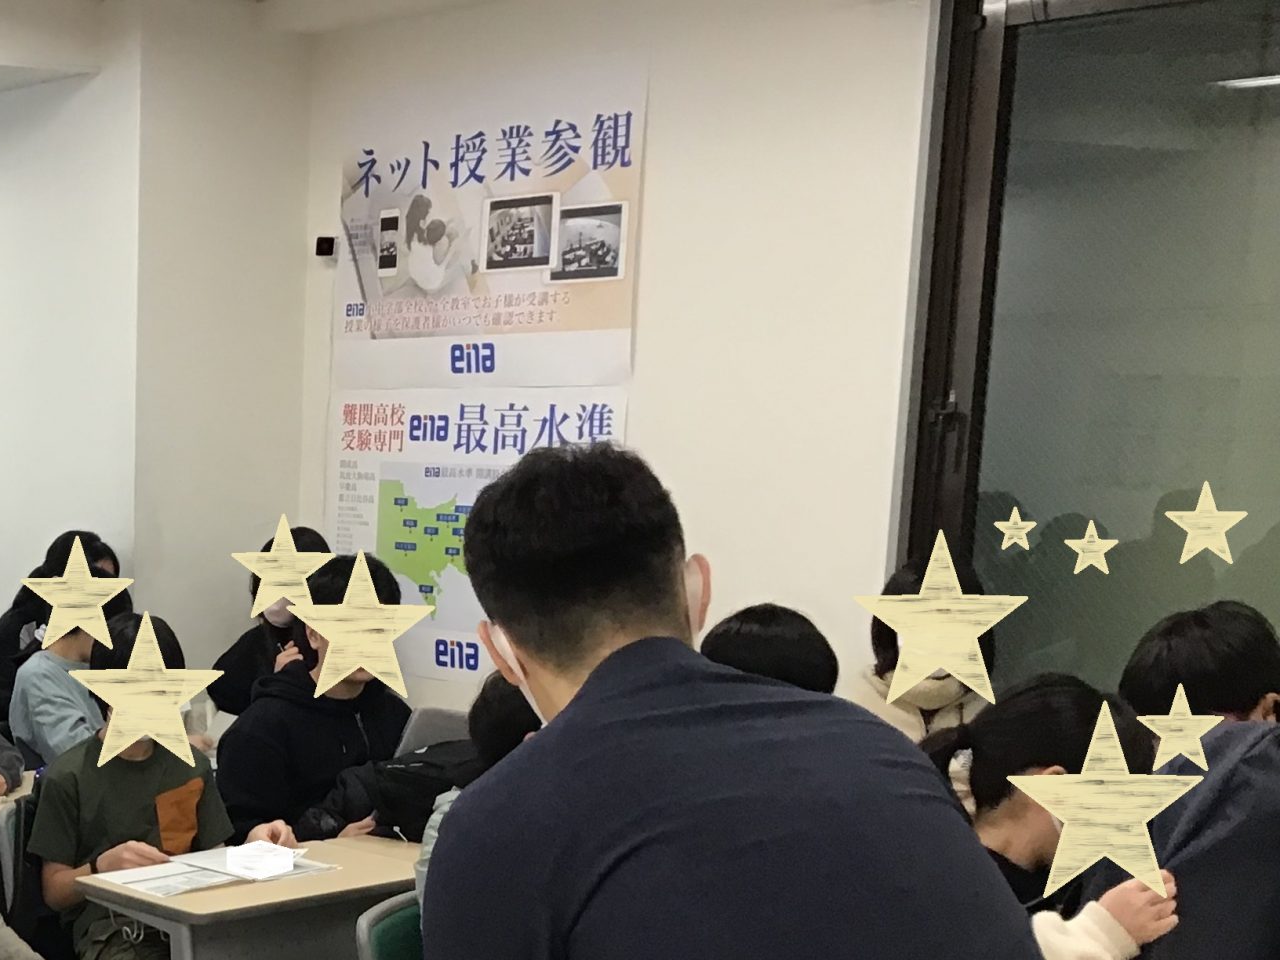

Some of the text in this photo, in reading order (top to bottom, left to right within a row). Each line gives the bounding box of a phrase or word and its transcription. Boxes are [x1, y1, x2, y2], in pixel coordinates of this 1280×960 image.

[356, 111, 633, 198] ネット授業参観
[346, 303, 365, 317] ena
[451, 343, 495, 373] ena
[343, 403, 405, 426] 難関高校
[341, 429, 404, 452] 受験専門
[409, 402, 614, 455] ena 最高水準
[424, 466, 440, 477] ena
[435, 639, 479, 671] ena
